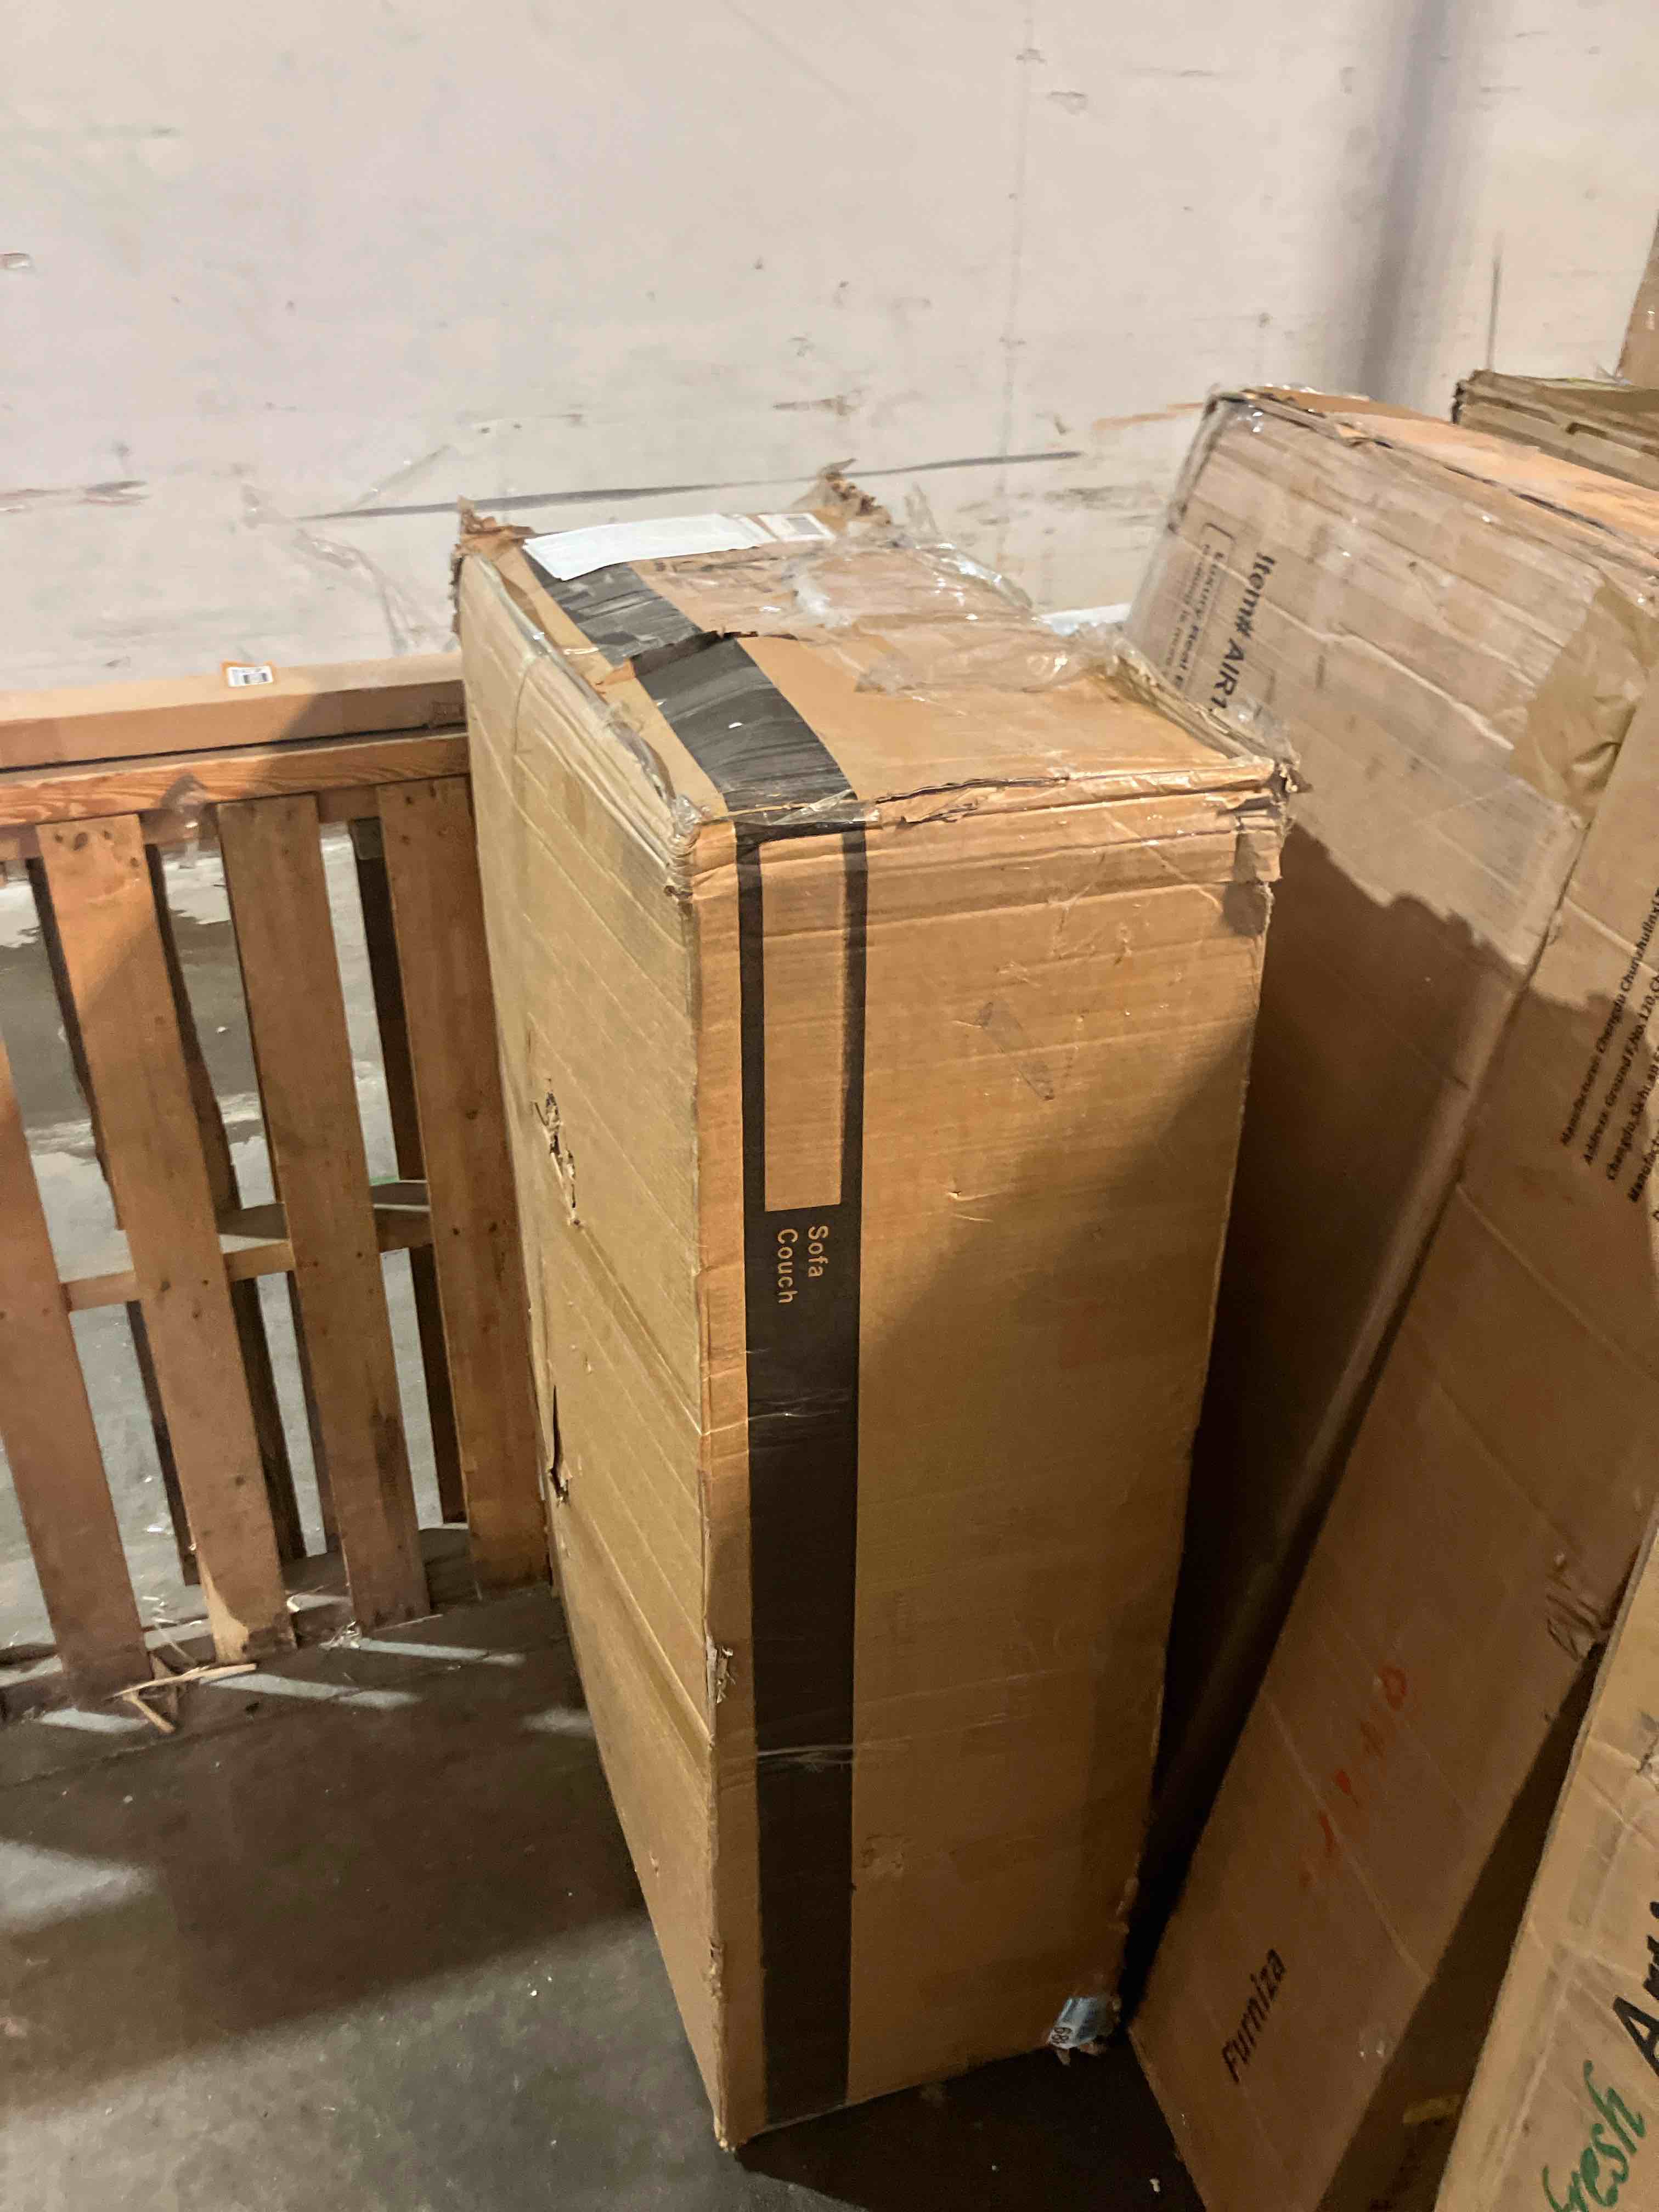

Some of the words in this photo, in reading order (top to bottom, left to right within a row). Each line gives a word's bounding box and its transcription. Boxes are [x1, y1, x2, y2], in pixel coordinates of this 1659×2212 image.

[1235, 551, 1276, 638] Item#
[1209, 638, 1245, 712] AIR1
[777, 1228, 798, 1304] Couch
[808, 1225, 829, 1278] Sofa
